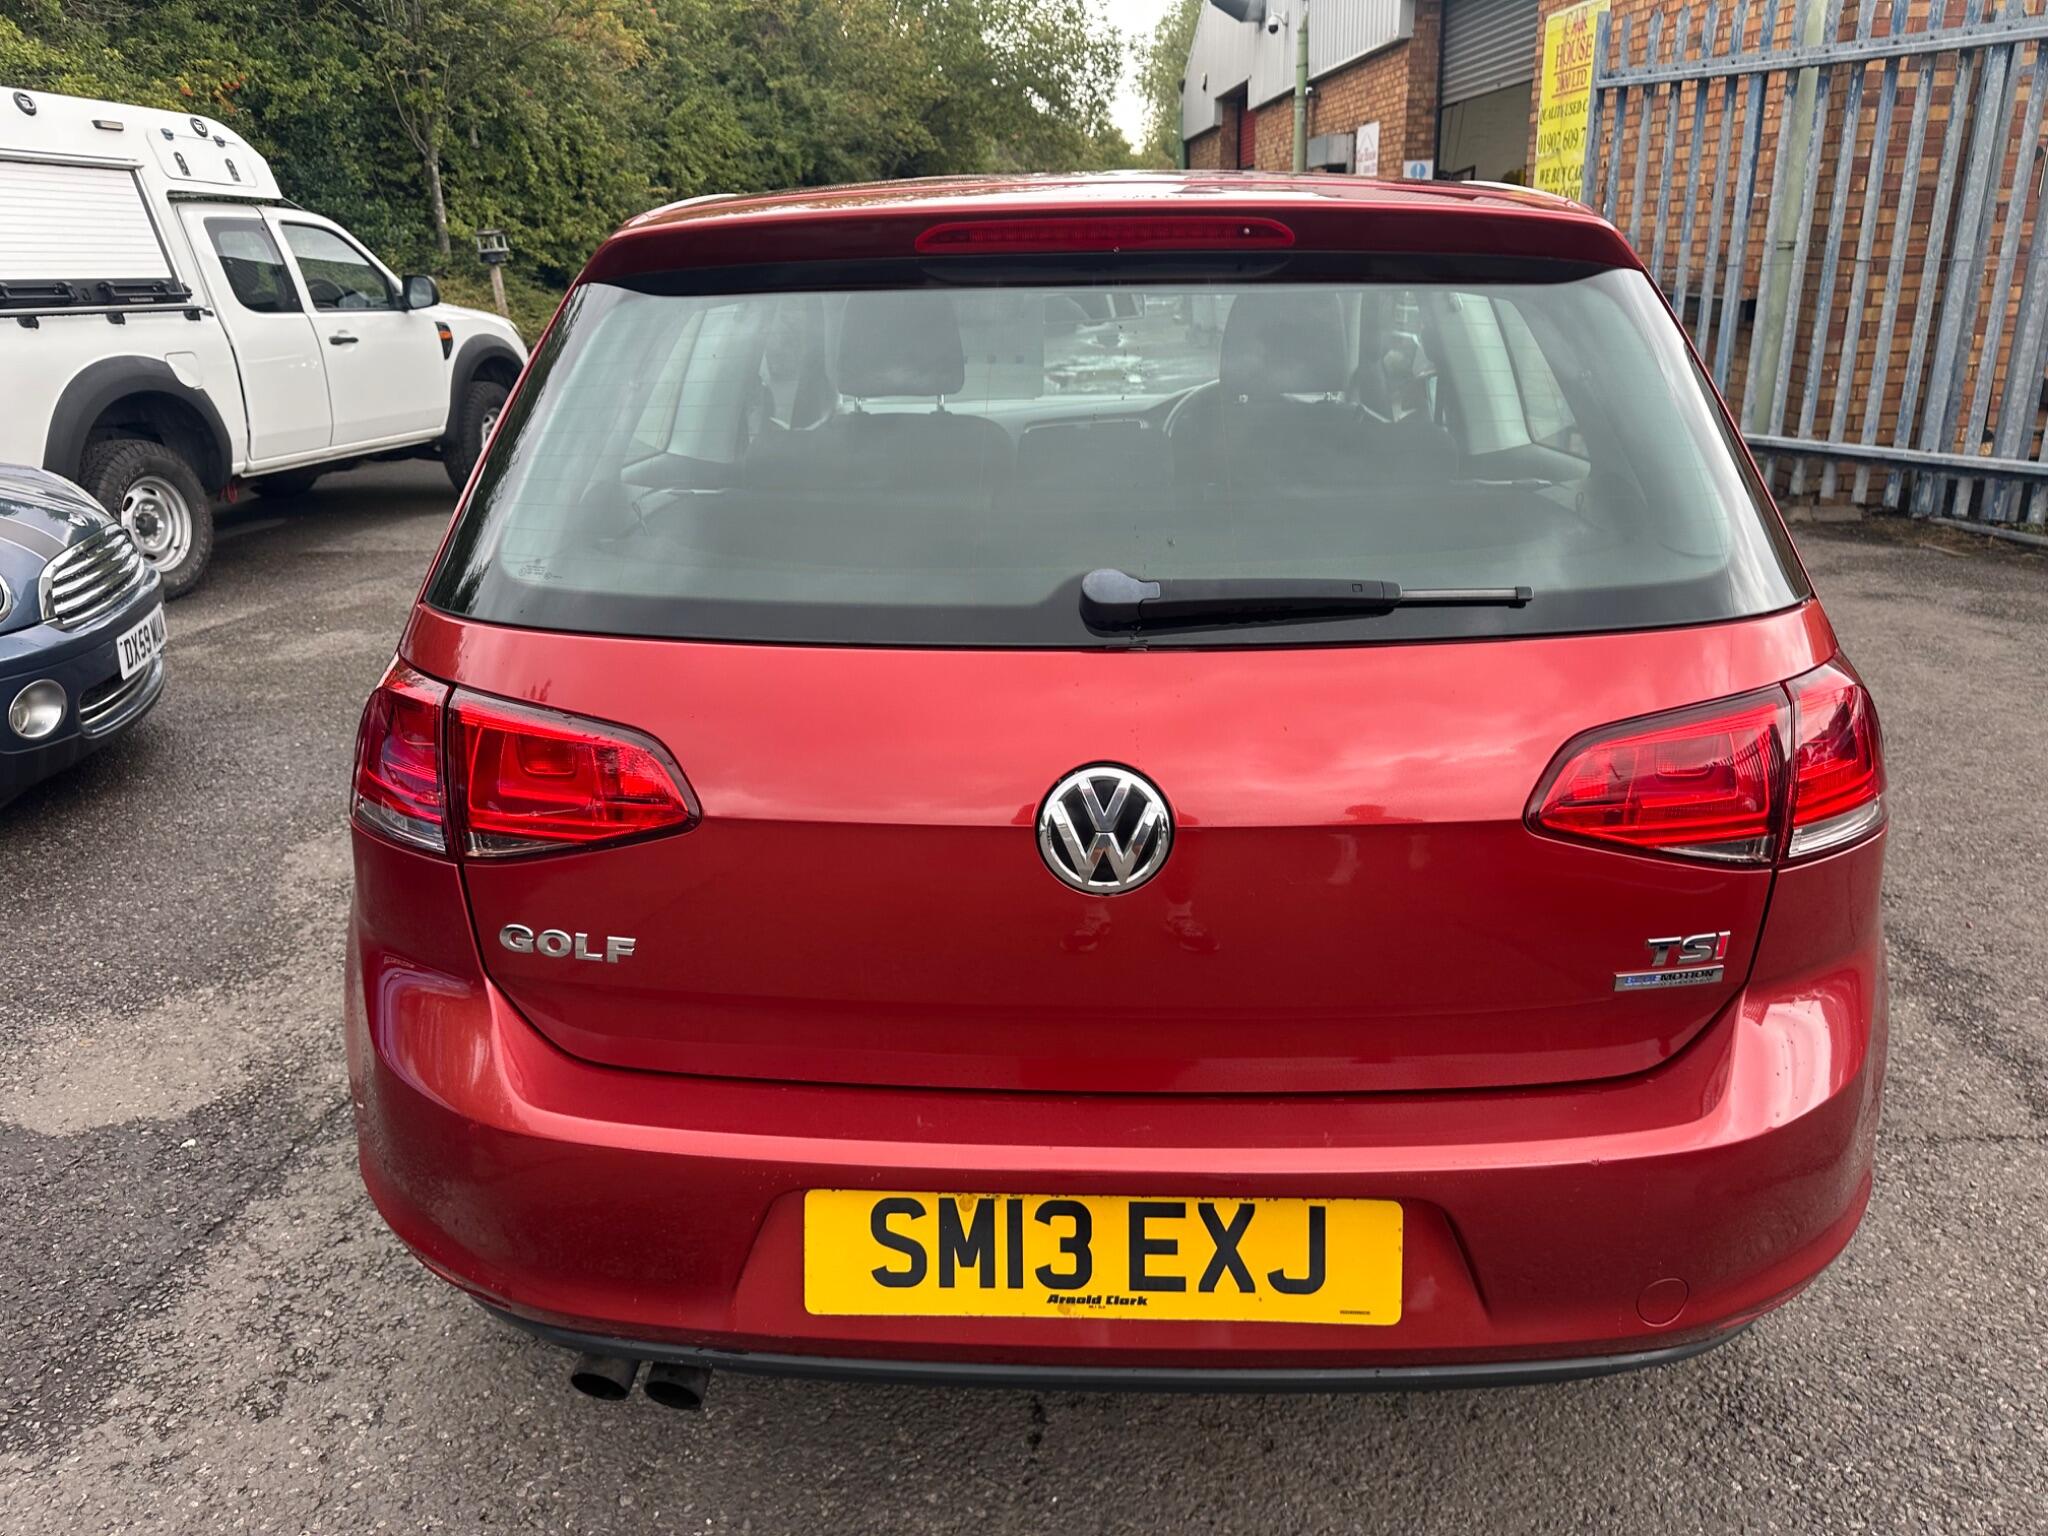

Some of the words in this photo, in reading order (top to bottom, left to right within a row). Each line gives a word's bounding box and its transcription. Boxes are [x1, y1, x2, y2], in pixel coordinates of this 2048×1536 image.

[1564, 6, 1588, 36] CAR
[1555, 33, 1593, 69] HOUSE
[1571, 69, 1587, 88] LTD
[1562, 128, 1579, 151] 609
[124, 624, 151, 669] DX59
[499, 923, 637, 964] GOLF
[1648, 930, 1731, 966] TSI
[870, 1196, 1094, 1291] SM13
[1127, 1200, 1327, 1295] EXJ
[1046, 1294, 1102, 1305] Arnold
[1105, 1295, 1148, 1306] Clark
